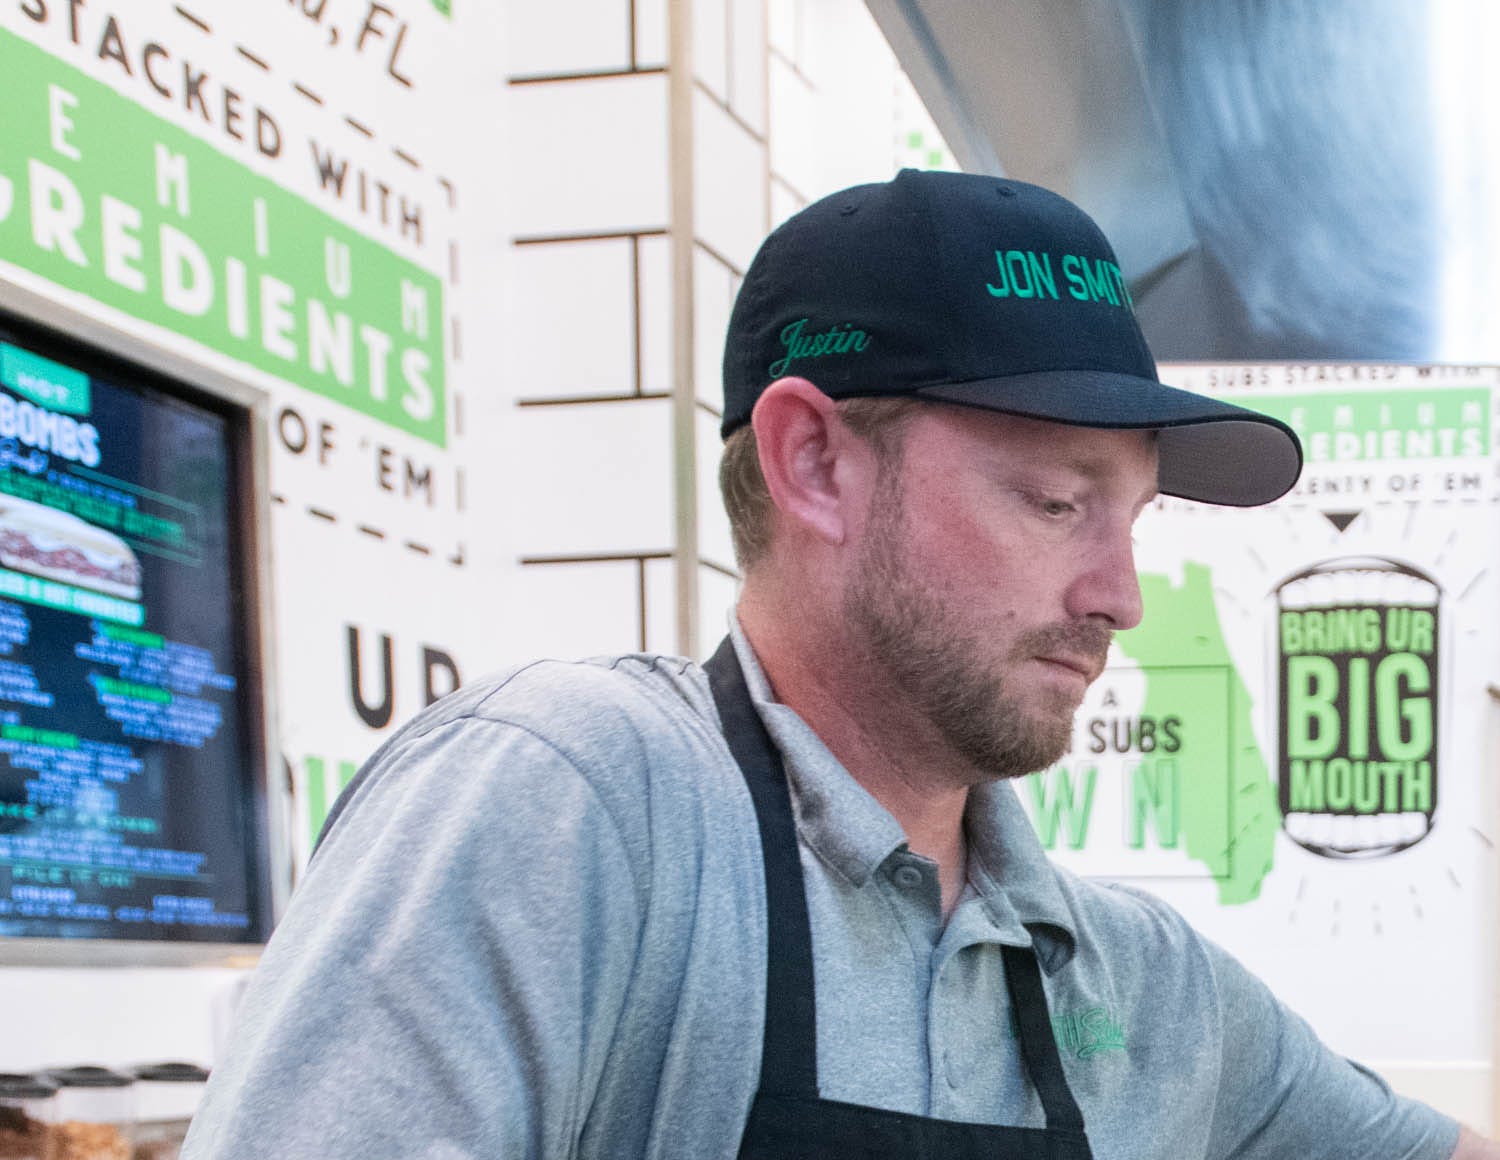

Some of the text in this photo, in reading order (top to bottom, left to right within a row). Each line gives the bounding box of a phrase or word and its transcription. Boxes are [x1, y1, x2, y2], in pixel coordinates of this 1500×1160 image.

[356, 3, 414, 88] FL
[310, 139, 425, 246] WITH
[986, 250, 1134, 310] JON SMIT
[768, 319, 870, 378] Justin
[1207, 366, 1270, 388] SUBS
[278, 409, 334, 467] OF
[1388, 474, 1423, 493] OF
[1280, 606, 1435, 656] BRING UR
[1089, 716, 1183, 754] SUBS
[1287, 652, 1433, 761] BIG
[1289, 758, 1431, 814] MOUTH
